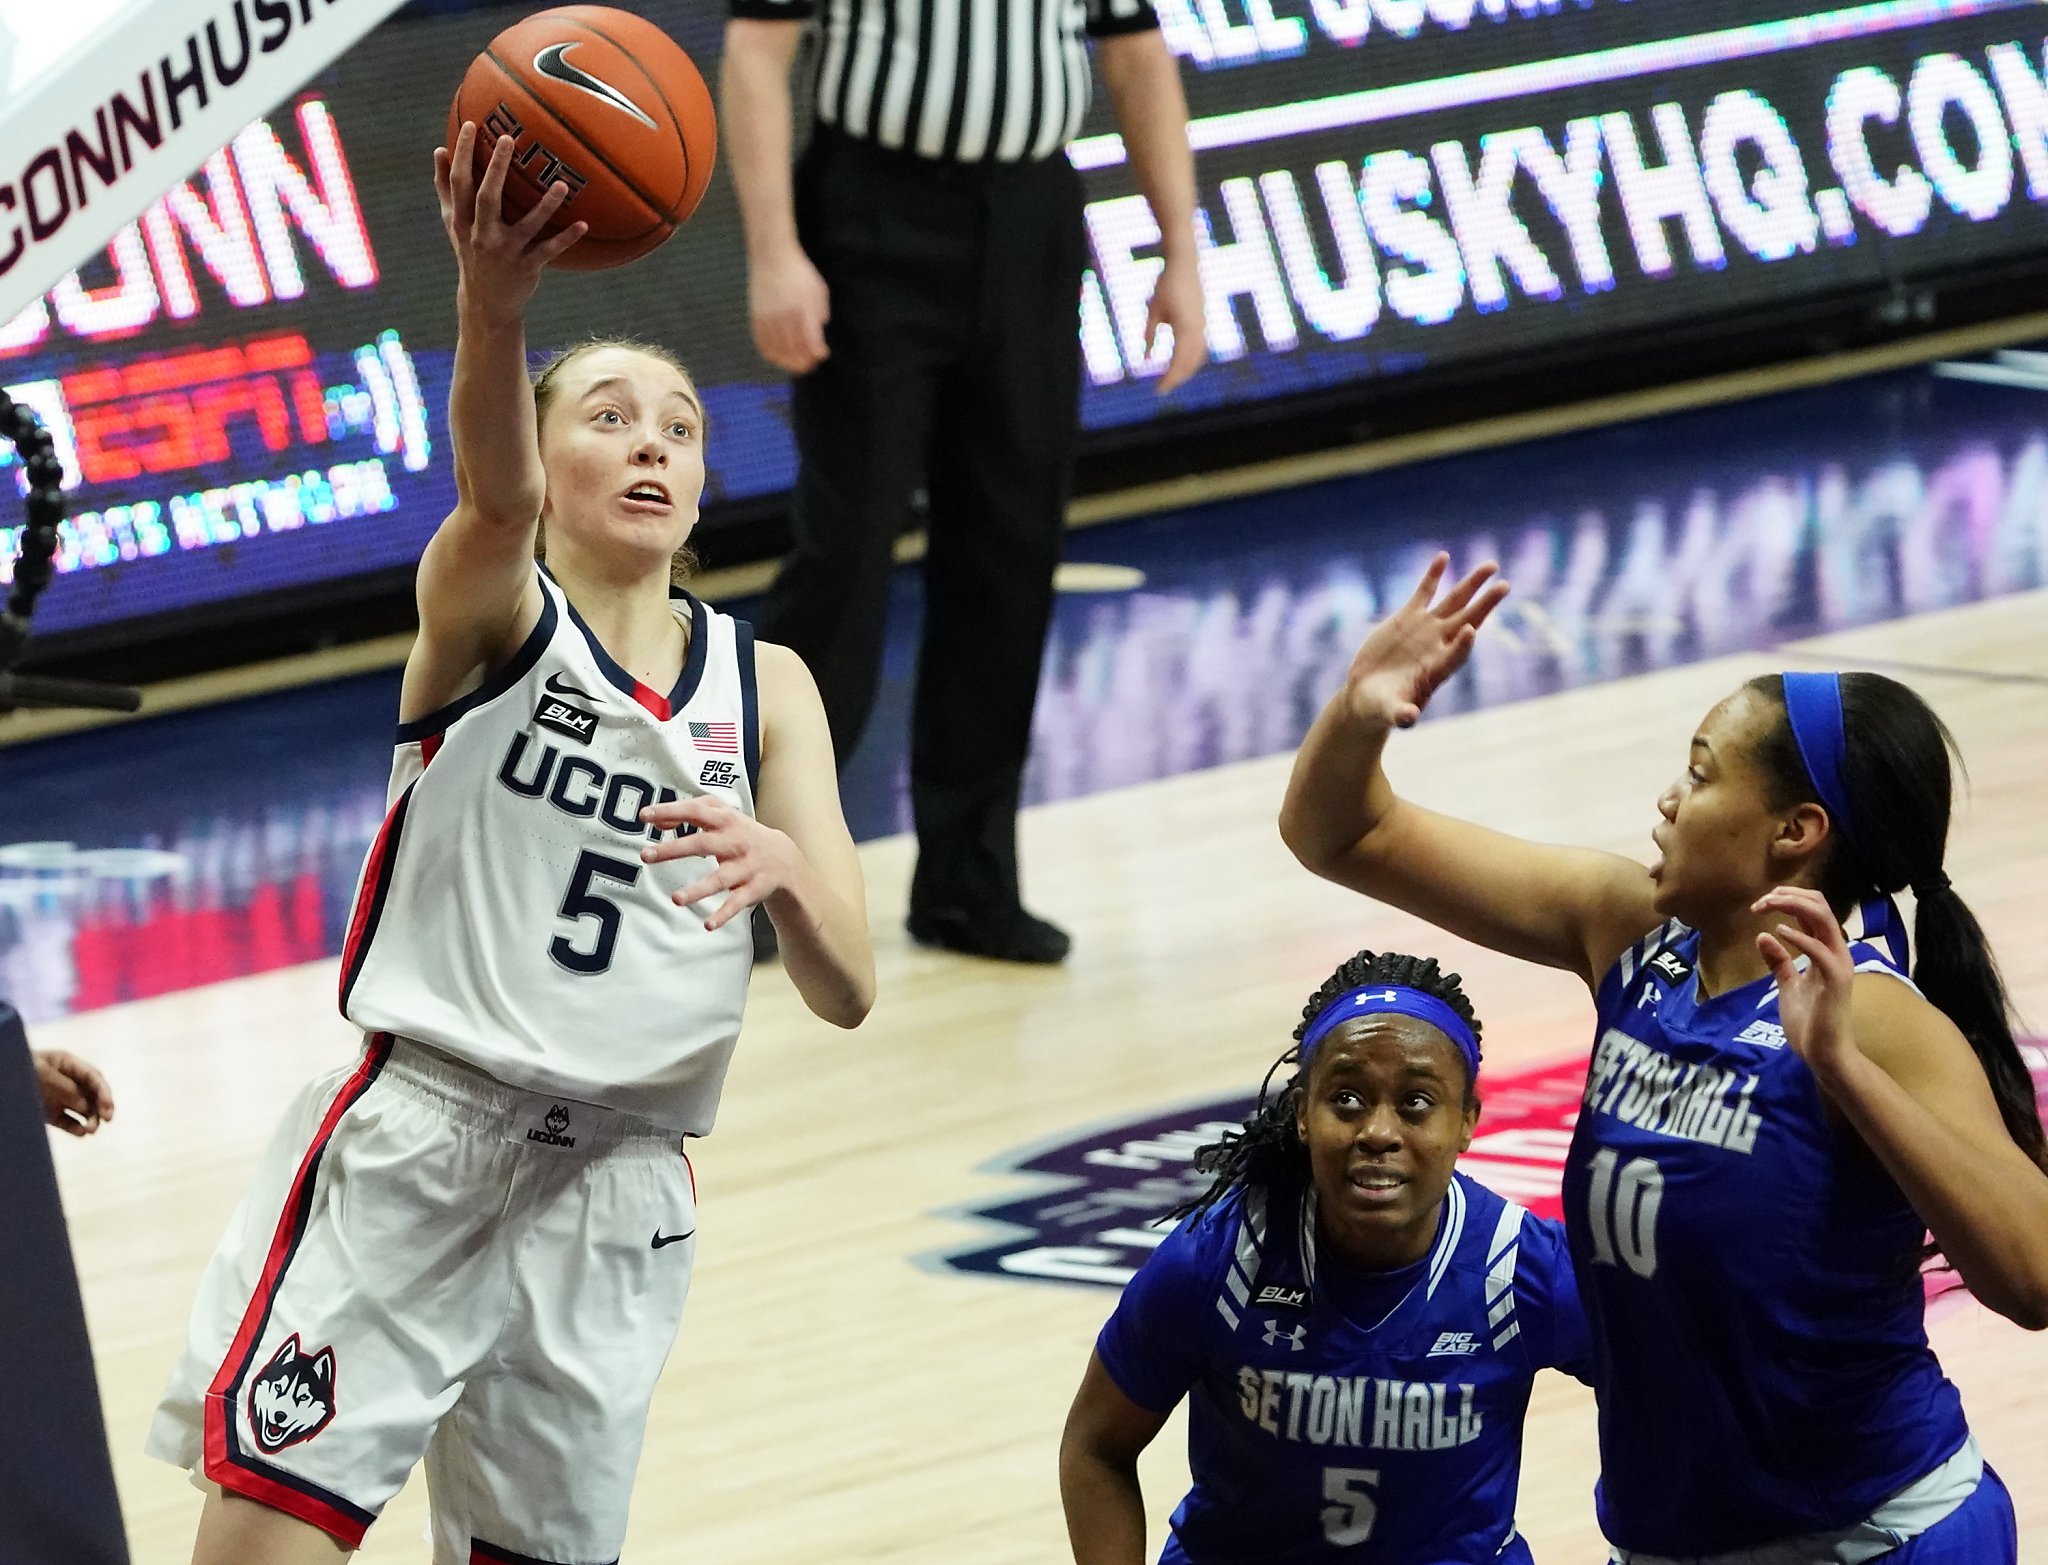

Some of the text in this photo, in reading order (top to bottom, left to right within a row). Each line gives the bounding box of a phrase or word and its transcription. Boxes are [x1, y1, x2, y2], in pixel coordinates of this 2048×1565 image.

[0, 0, 333, 276] CONNHUS
[62, 333, 330, 484] ESPN
[543, 702, 593, 730] BLM
[497, 729, 708, 842] UCON
[699, 771, 741, 785] EAST
[703, 759, 735, 773] BIG
[547, 846, 643, 976] 5
[526, 1128, 576, 1148] UCONN
[1586, 1147, 1665, 1280] 10
[1259, 1285, 1306, 1303] BLM
[1430, 1342, 1482, 1353] EAST
[1436, 1331, 1474, 1344] BIG
[1236, 1365, 1484, 1450] SETON HALL
[1320, 1466, 1380, 1547] 5
